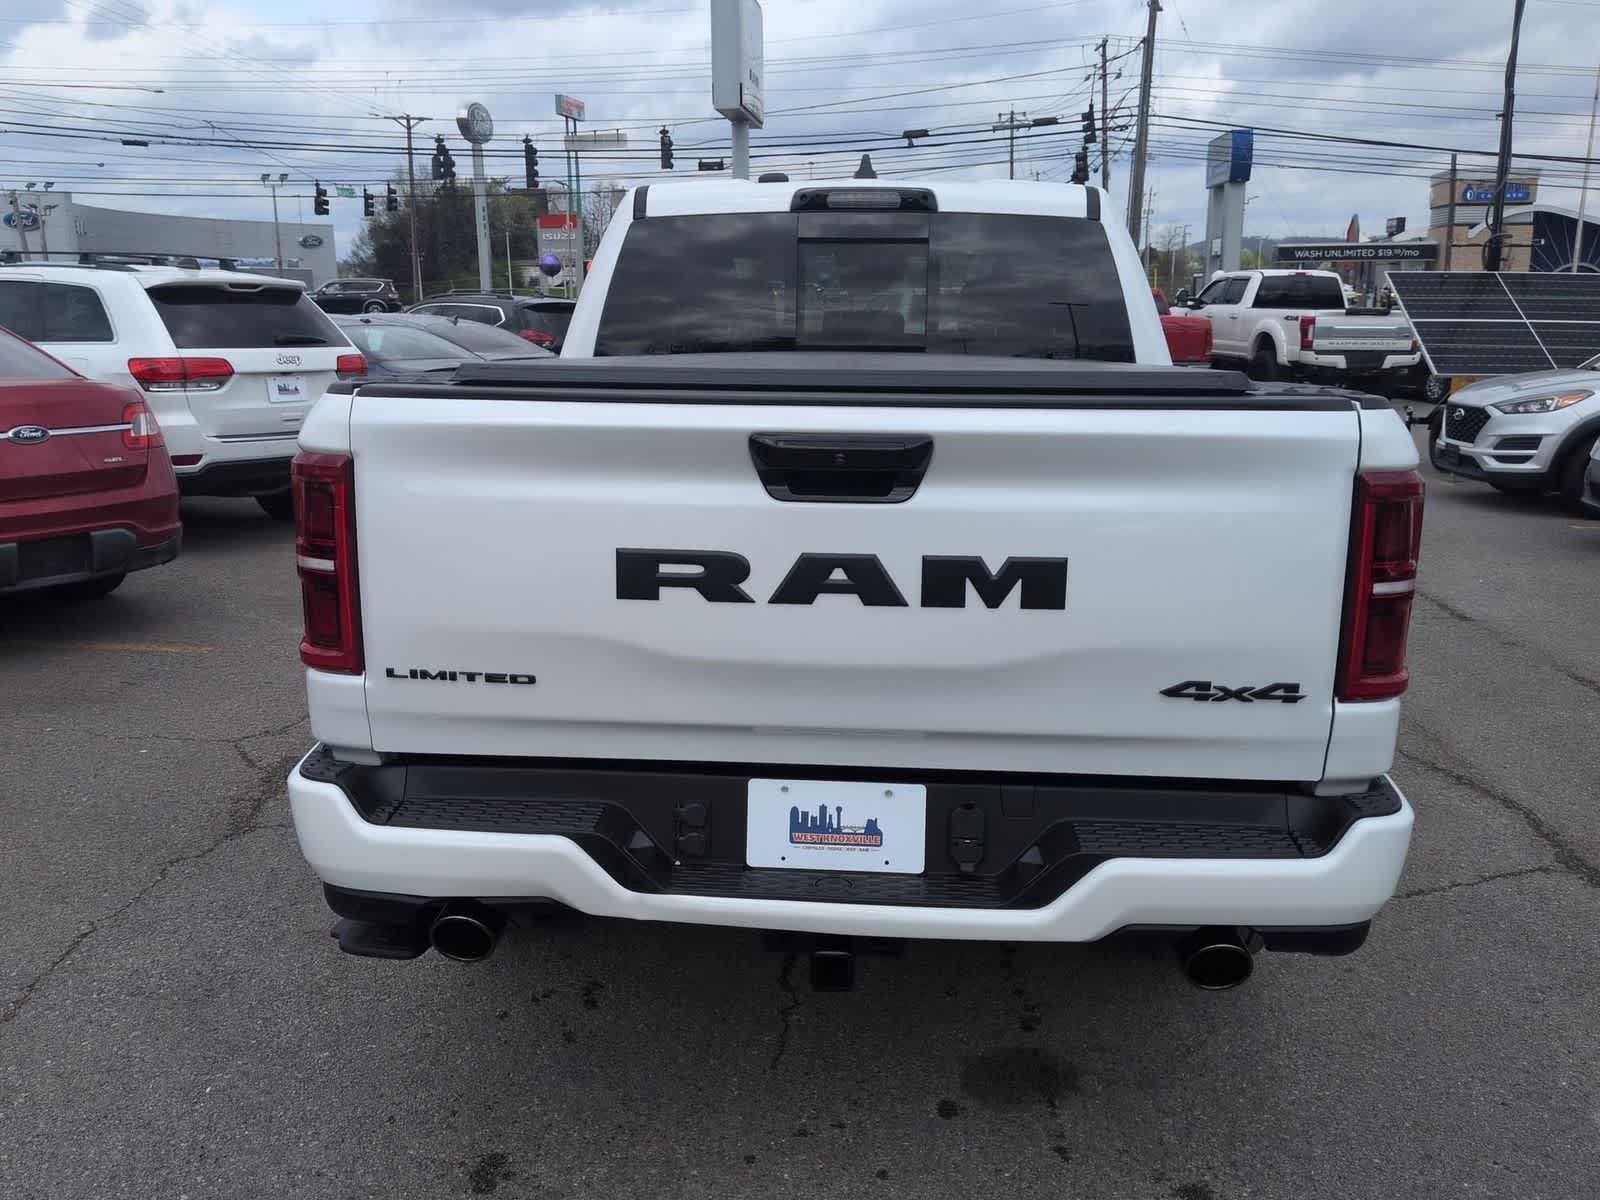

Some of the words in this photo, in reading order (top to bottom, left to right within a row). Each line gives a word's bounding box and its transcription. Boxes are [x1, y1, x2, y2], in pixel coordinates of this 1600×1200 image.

[1295, 250, 1323, 258] WASH
[1325, 249, 1375, 258] UNLIMITED
[277, 353, 301, 367] Jeep
[19, 428, 42, 439] Ford
[616, 547, 1068, 610] RAM
[386, 667, 537, 685] LIMITED
[1159, 680, 1308, 703] 4x4
[793, 832, 820, 843] WEST
[823, 834, 881, 845] KNOXVILLE
